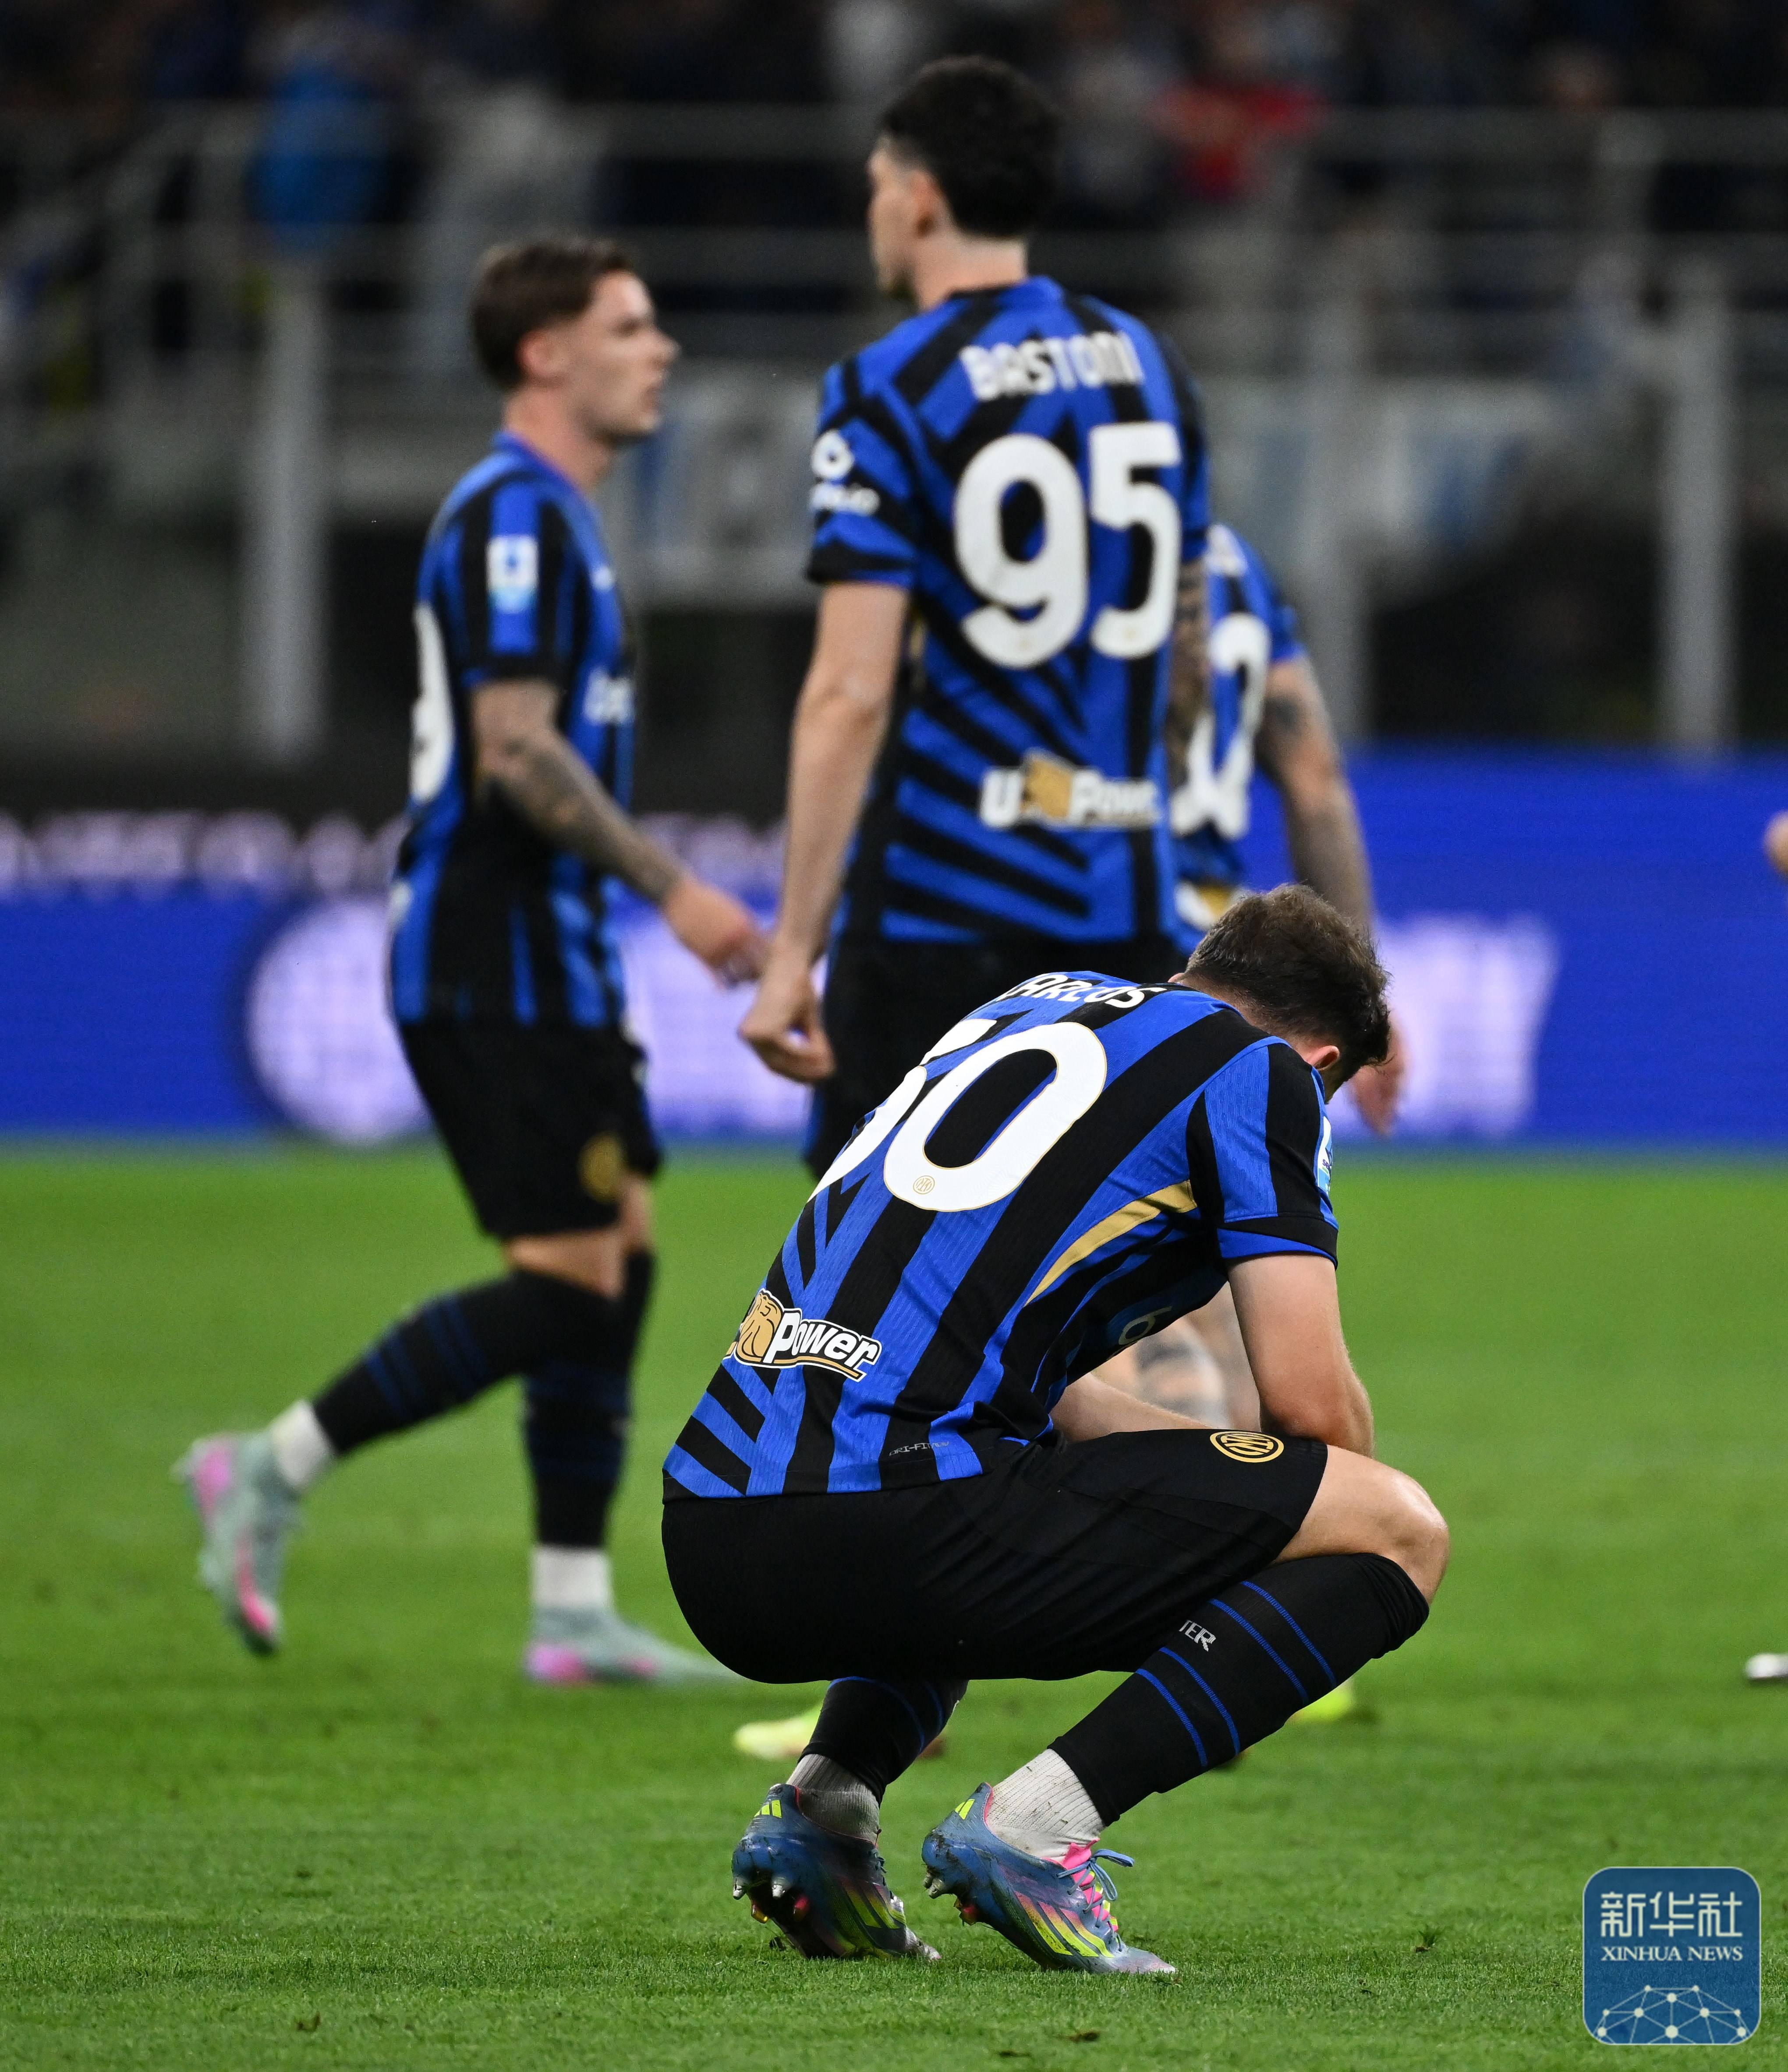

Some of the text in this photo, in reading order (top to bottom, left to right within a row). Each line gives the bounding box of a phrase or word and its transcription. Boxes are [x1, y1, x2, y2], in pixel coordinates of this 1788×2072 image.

[960, 332, 1144, 400] BASTONI
[953, 422, 1182, 669] 95
[989, 969, 1167, 1008] ARLOS
[762, 1312, 880, 1368] Power
